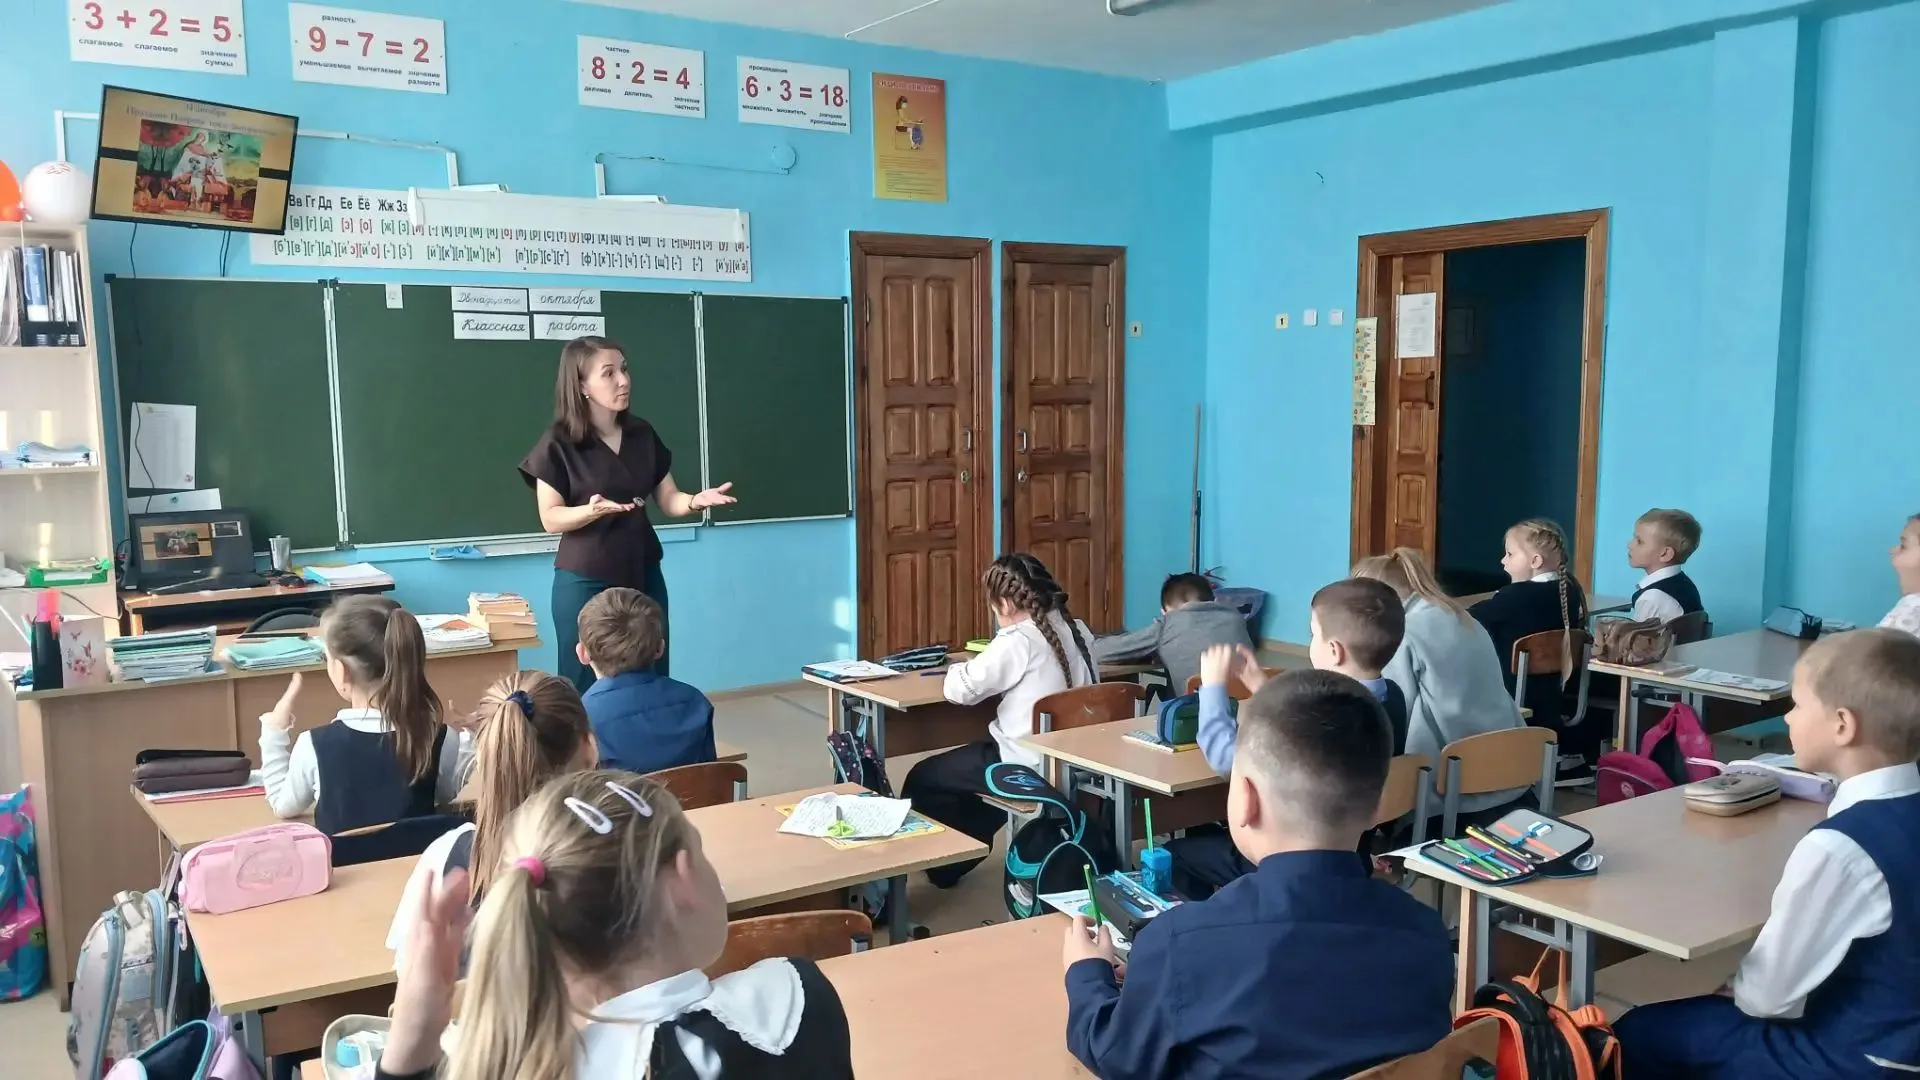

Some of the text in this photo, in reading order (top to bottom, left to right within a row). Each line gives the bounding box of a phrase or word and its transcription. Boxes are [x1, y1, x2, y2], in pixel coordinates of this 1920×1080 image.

[84, 2, 103, 29] 3
[149, 9, 168, 36] 2
[213, 16, 232, 42] 5
[322, 14, 356, 24] разность
[79, 38, 178, 53] слагаемое слагаемое
[309, 26, 326, 52] 9
[357, 32, 374, 56] 7
[413, 38, 429, 63] 2
[201, 50, 237, 58] значение
[205, 58, 233, 67] суммы
[300, 60, 402, 75] уменьшаемое вычитаемое
[749, 65, 788, 73] произведение
[408, 70, 440, 78] значение
[592, 56, 606, 79] 8
[632, 61, 645, 84] 2
[676, 68, 690, 89] 4
[407, 78, 440, 87] разности
[624, 90, 653, 98] делитель
[746, 76, 758, 97] 6
[780, 80, 792, 101] 3
[820, 85, 844, 107] 18
[742, 104, 773, 112] множитель
[305, 195, 315, 208] Гг
[318, 196, 332, 210] Дд
[358, 195, 370, 211] Ёё
[378, 198, 394, 212] Жж
[540, 288, 595, 310] октября
[462, 316, 598, 335] Классная работа
